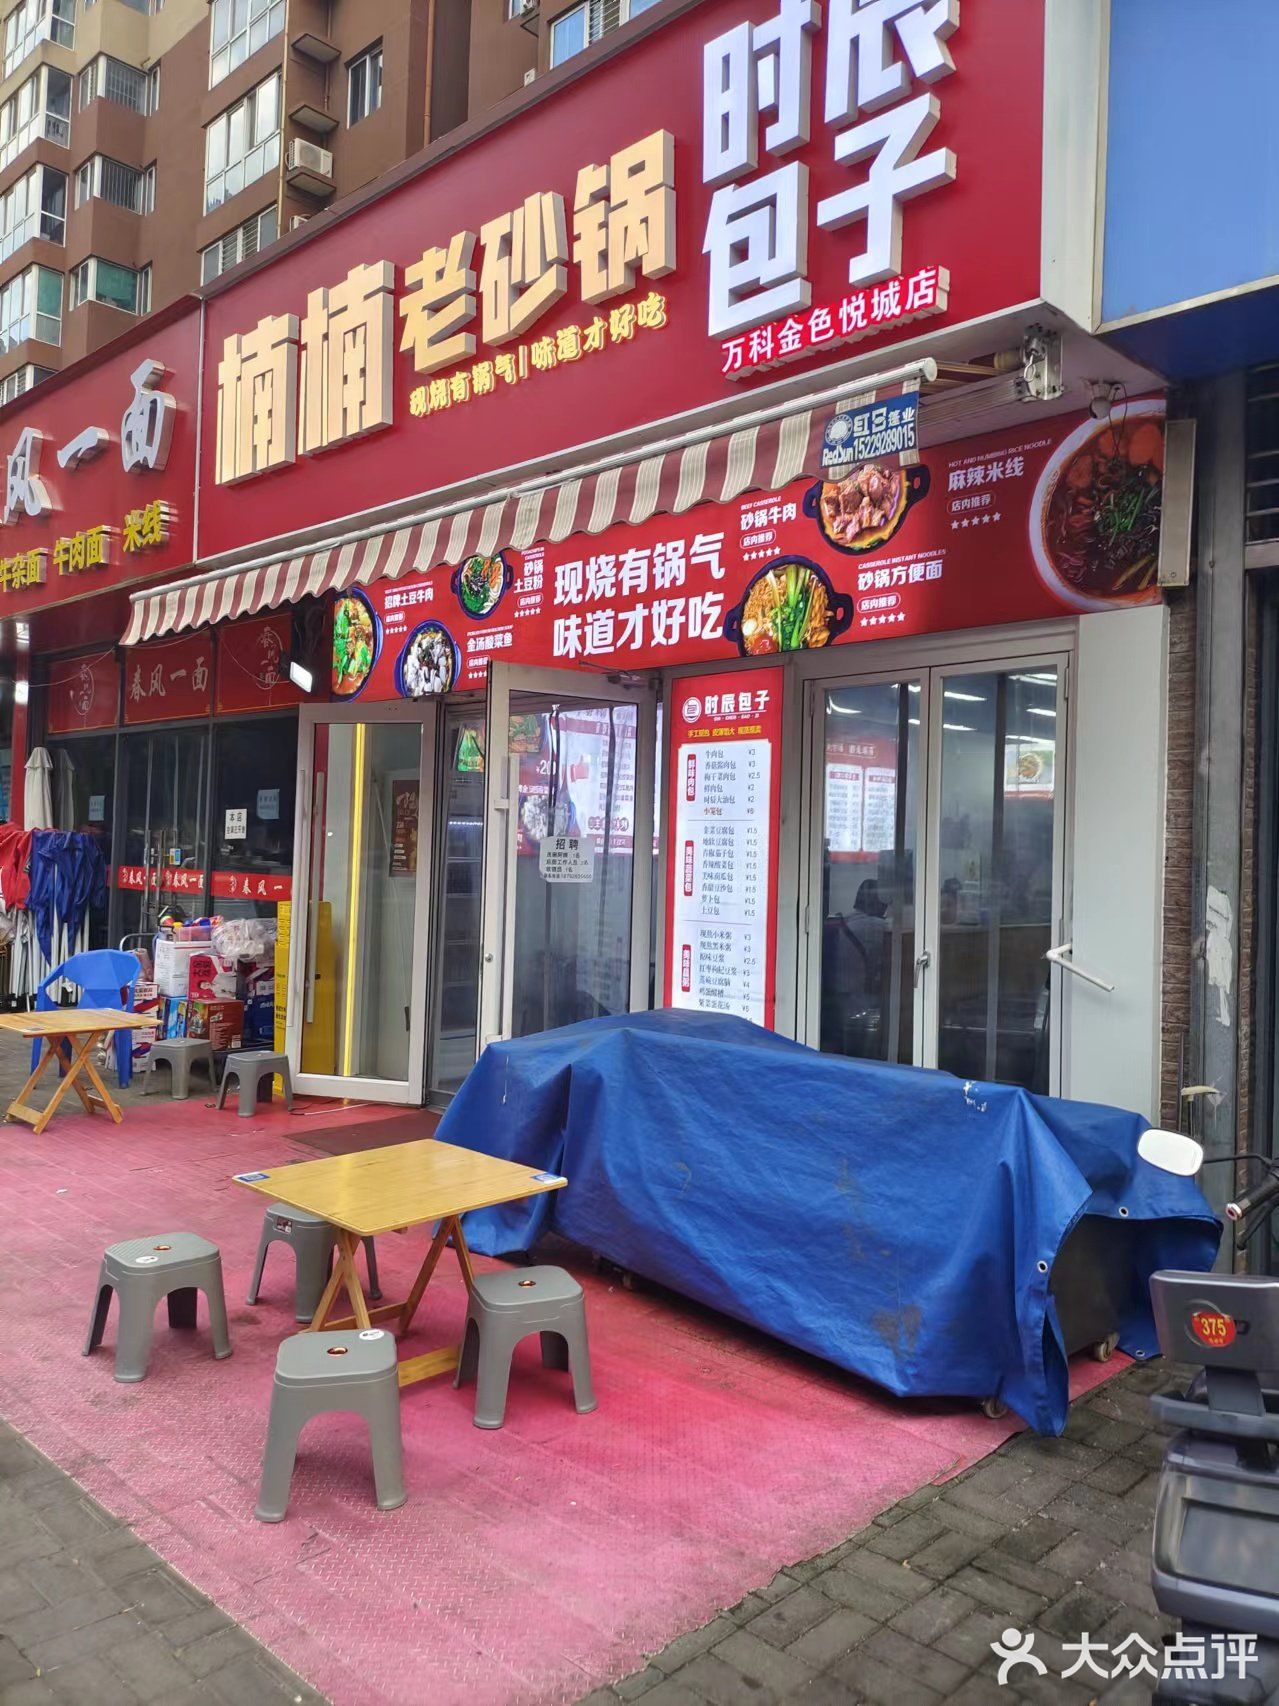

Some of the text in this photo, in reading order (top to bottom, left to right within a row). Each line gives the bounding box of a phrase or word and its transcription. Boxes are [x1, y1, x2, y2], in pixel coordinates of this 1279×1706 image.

[703, 0, 958, 183] 时辰
[702, 92, 956, 337] 包子
[215, 128, 676, 486] 楠楠老砂锅
[721, 265, 948, 375] 万科金色悦城店
[853, 422, 915, 461] 15229289015
[948, 456, 1024, 492] 麻辣米线
[741, 502, 797, 531] 砂锅牛肉
[951, 493, 990, 512] 店内推荐
[54, 525, 111, 576] 牛肉面
[123, 500, 170, 553] 米线
[513, 573, 544, 594] 土豆粉
[524, 559, 544, 577] 砂锅
[553, 531, 726, 607] 现烧有锅气
[858, 559, 943, 591] 砂锅方便面
[552, 591, 724, 660] 味道才好吃
[129, 656, 208, 702] 春风一面
[705, 689, 770, 715] 时辰包子
[556, 838, 579, 851] 招聘
[1201, 1317, 1227, 1337] 375
